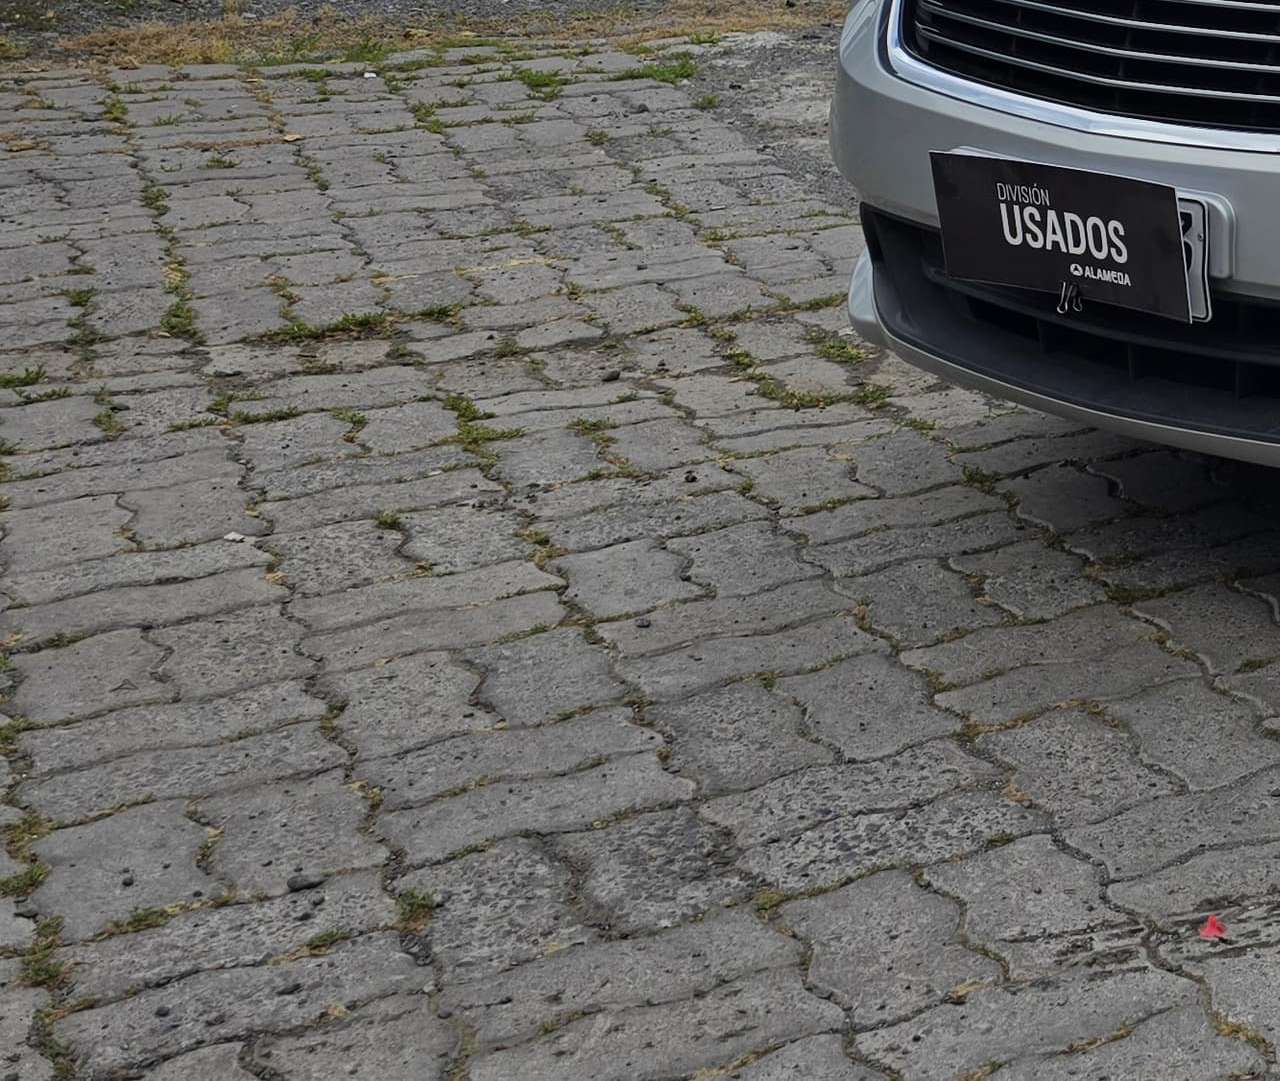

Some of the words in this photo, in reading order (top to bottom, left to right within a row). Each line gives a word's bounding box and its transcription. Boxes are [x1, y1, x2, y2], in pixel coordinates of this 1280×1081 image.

[996, 182, 1050, 207] DIVISIÓN
[1000, 202, 1128, 264] USADOS
[1084, 266, 1132, 287] ALAMEDA
